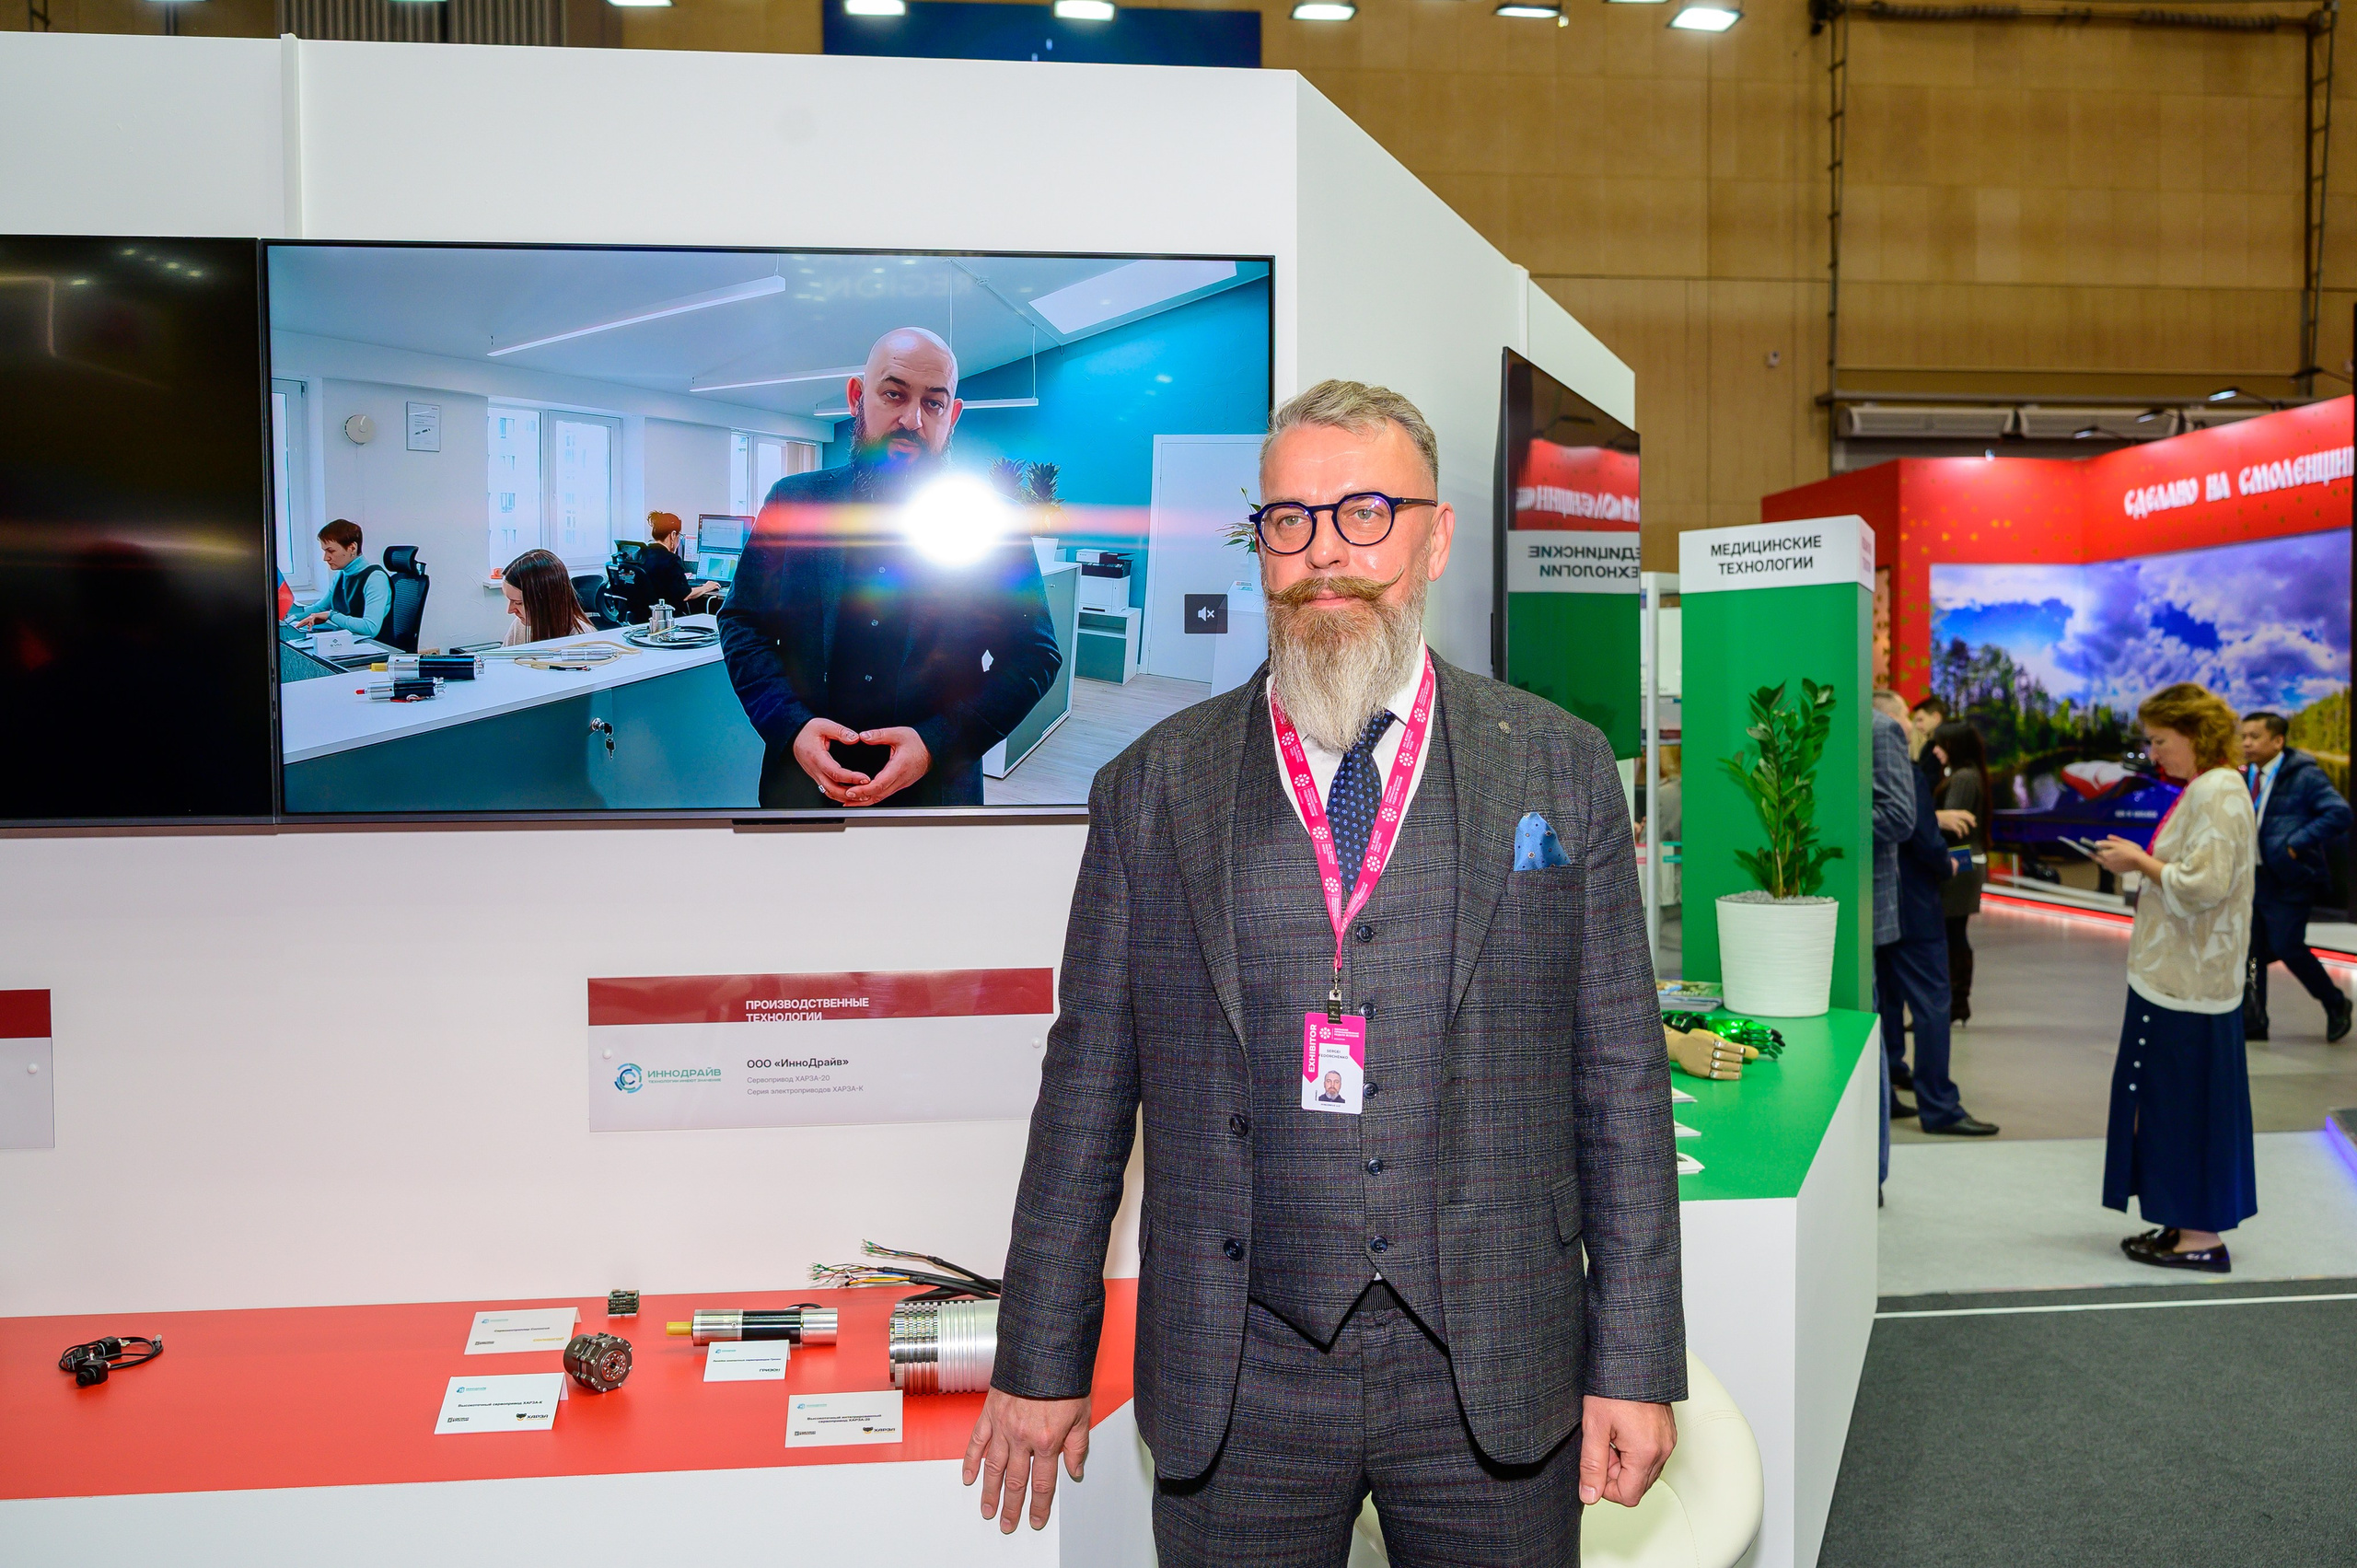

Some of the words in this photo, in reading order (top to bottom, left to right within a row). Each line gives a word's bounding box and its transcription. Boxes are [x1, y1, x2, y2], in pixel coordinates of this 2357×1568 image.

[2205, 470, 2231, 503] НА
[1711, 535, 1822, 557] МЕДИЦИНСКИЕ
[1719, 556, 1814, 575] ТЕХНОЛОГИИ
[746, 997, 869, 1010] ПРОИЗВОДСТВЕННЫЕ
[746, 1012, 823, 1022] ТЕХНОЛОГИИ
[1308, 1024, 1318, 1073] EXHIBITOR
[747, 1059, 772, 1068] ООО
[774, 1057, 849, 1068] «ИнноДрайв»
[647, 1066, 722, 1078] ИННОДРАЙВ
